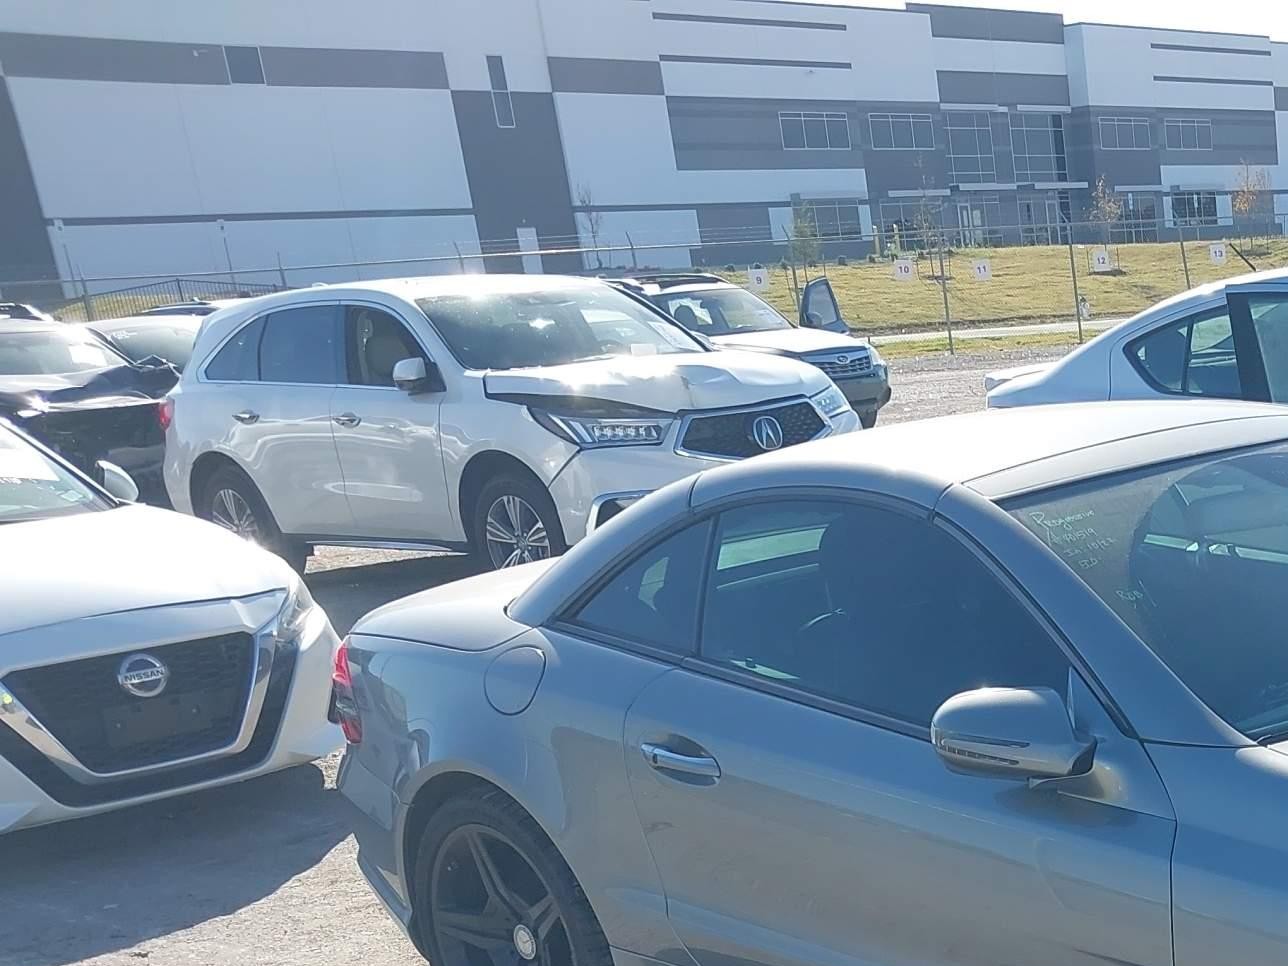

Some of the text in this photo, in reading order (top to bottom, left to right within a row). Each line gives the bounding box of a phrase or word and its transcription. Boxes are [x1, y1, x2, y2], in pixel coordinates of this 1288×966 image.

[1097, 256, 1107, 265] 12
[898, 266, 910, 274] 10
[976, 265, 987, 274] 11
[755, 276, 763, 285] 9
[124, 670, 165, 682] NISSAN
